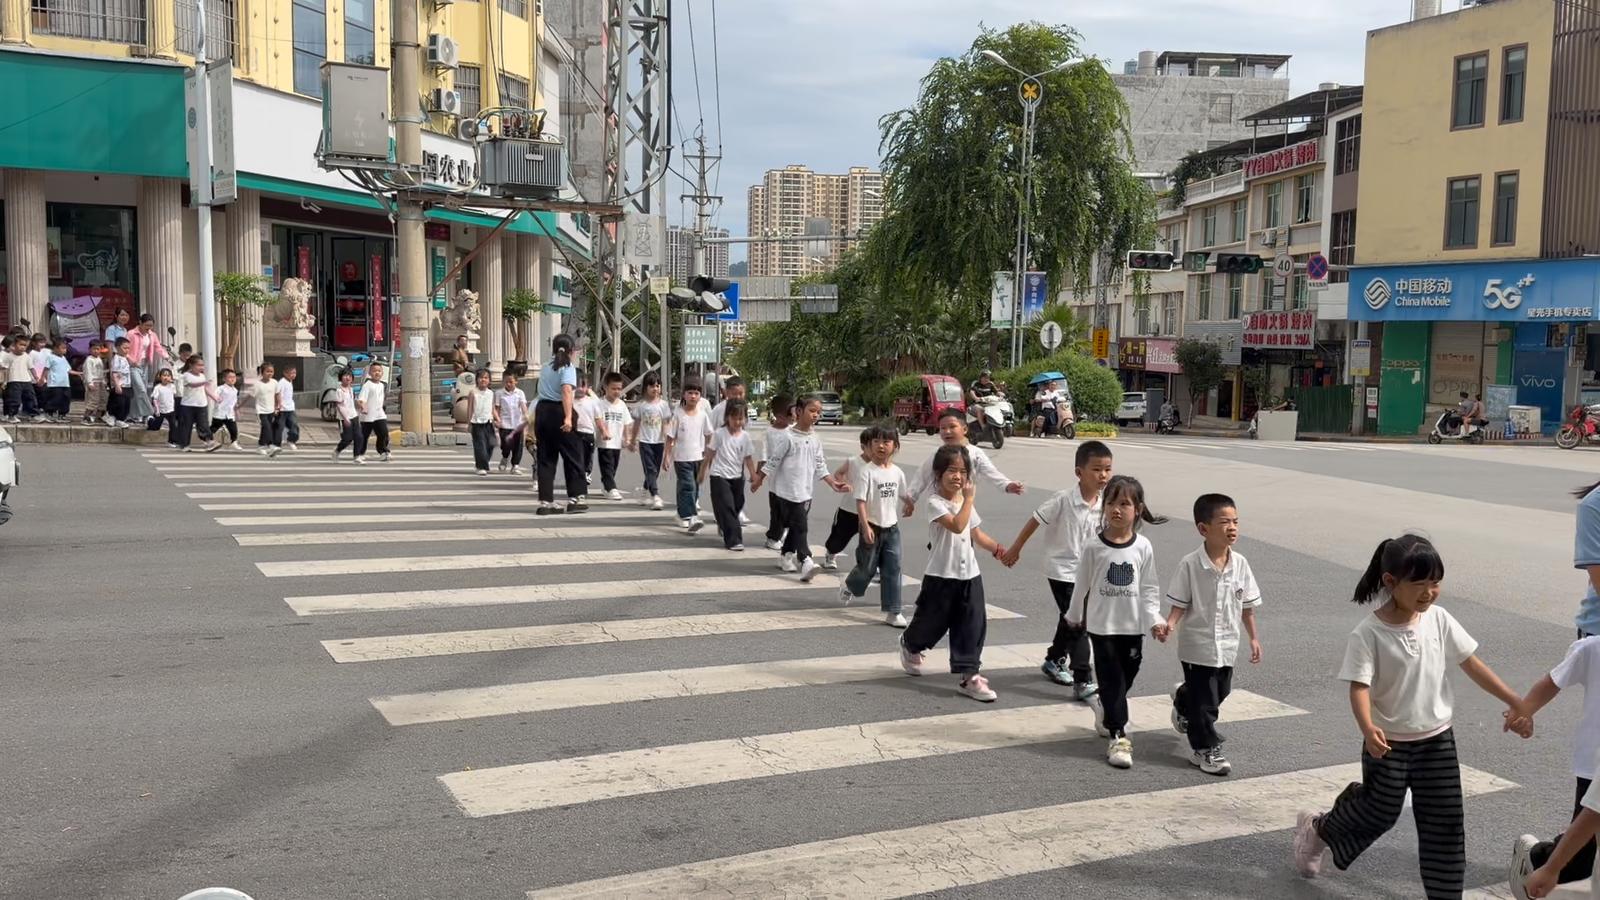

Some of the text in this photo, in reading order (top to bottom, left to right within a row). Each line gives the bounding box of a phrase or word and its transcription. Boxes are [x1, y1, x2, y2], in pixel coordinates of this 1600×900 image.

[423, 150, 478, 185] 国农业
[1278, 259, 1290, 272] 40
[1395, 277, 1452, 295] 中国移动
[1395, 295, 1451, 307] China Mobile
[1520, 376, 1556, 388] vivo
